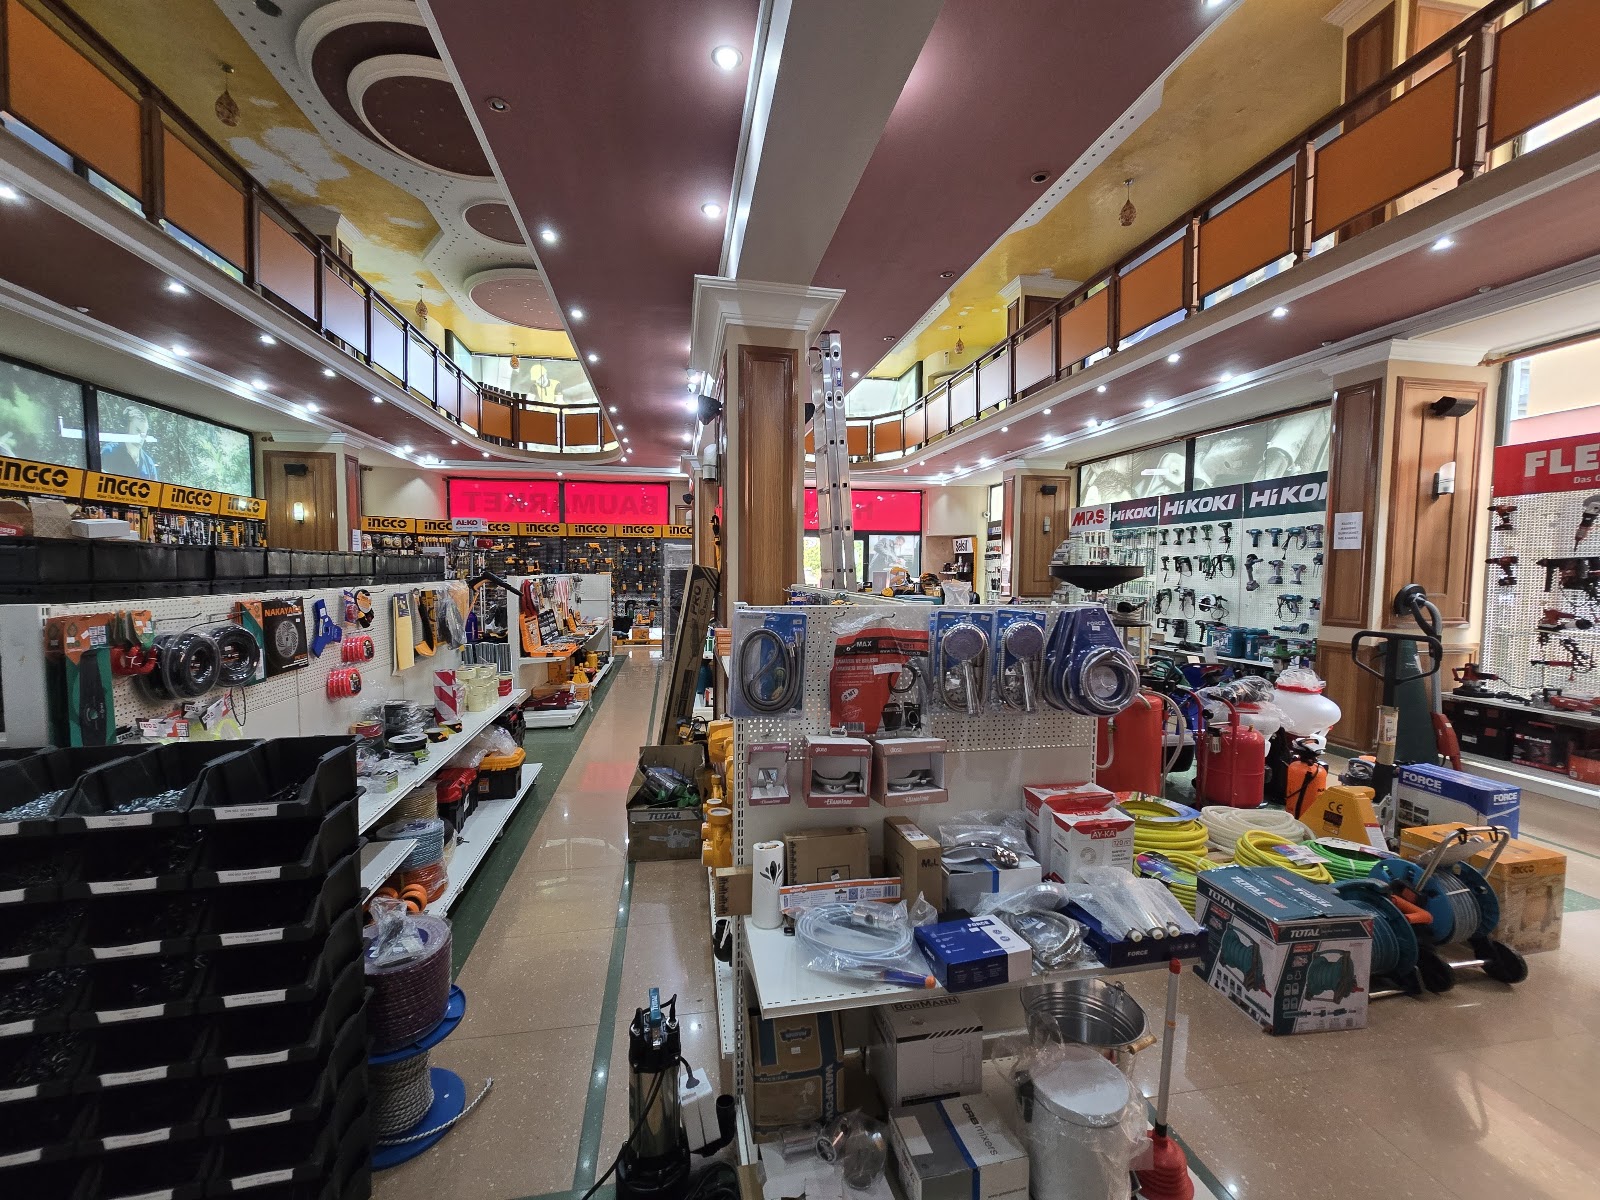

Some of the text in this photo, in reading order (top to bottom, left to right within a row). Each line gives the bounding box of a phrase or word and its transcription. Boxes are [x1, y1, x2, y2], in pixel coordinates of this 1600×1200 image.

[97, 476, 150, 498] INGCO
[171, 488, 212, 506] INGCO
[228, 497, 260, 513] INCO
[1164, 494, 1237, 516] HiKOKI
[1112, 506, 1158, 522] HiKOKI
[368, 518, 407, 528] INGCO
[424, 522, 452, 531] INGC
[488, 524, 510, 532] GCO
[526, 524, 560, 532] INGCO
[575, 525, 608, 534] INGCO
[623, 526, 654, 534] INGCO
[670, 526, 692, 534] INGC
[264, 606, 302, 617] NAKAYA
[118, 732, 133, 741] YATO
[1403, 771, 1442, 790] FORCE
[1494, 792, 1518, 802] FORCE
[648, 812, 682, 820] TOTAL
[1092, 831, 1116, 839] AY-KA
[1230, 876, 1266, 897] TOTAL
[1208, 888, 1236, 912] TOTAL
[967, 920, 990, 928] FORCE
[1290, 928, 1320, 938] TOTAL
[974, 1125, 998, 1156] mixers
